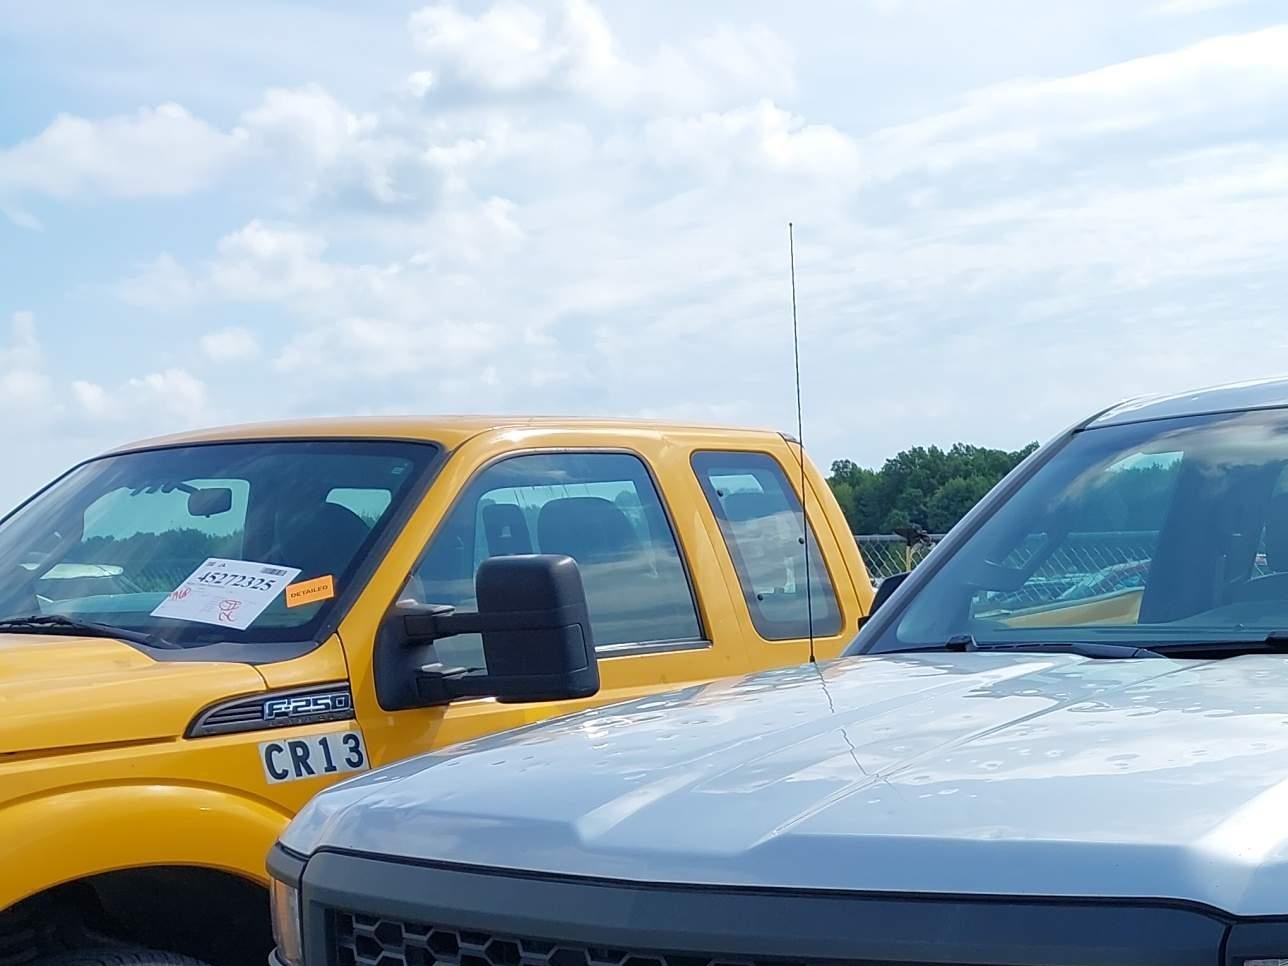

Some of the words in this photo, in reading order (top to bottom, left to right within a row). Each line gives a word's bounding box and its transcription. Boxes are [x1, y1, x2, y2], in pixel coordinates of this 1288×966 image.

[197, 571, 277, 592] 45272325
[290, 584, 329, 599] DETAILED
[264, 692, 351, 721] F-250
[264, 732, 364, 781] CR13
